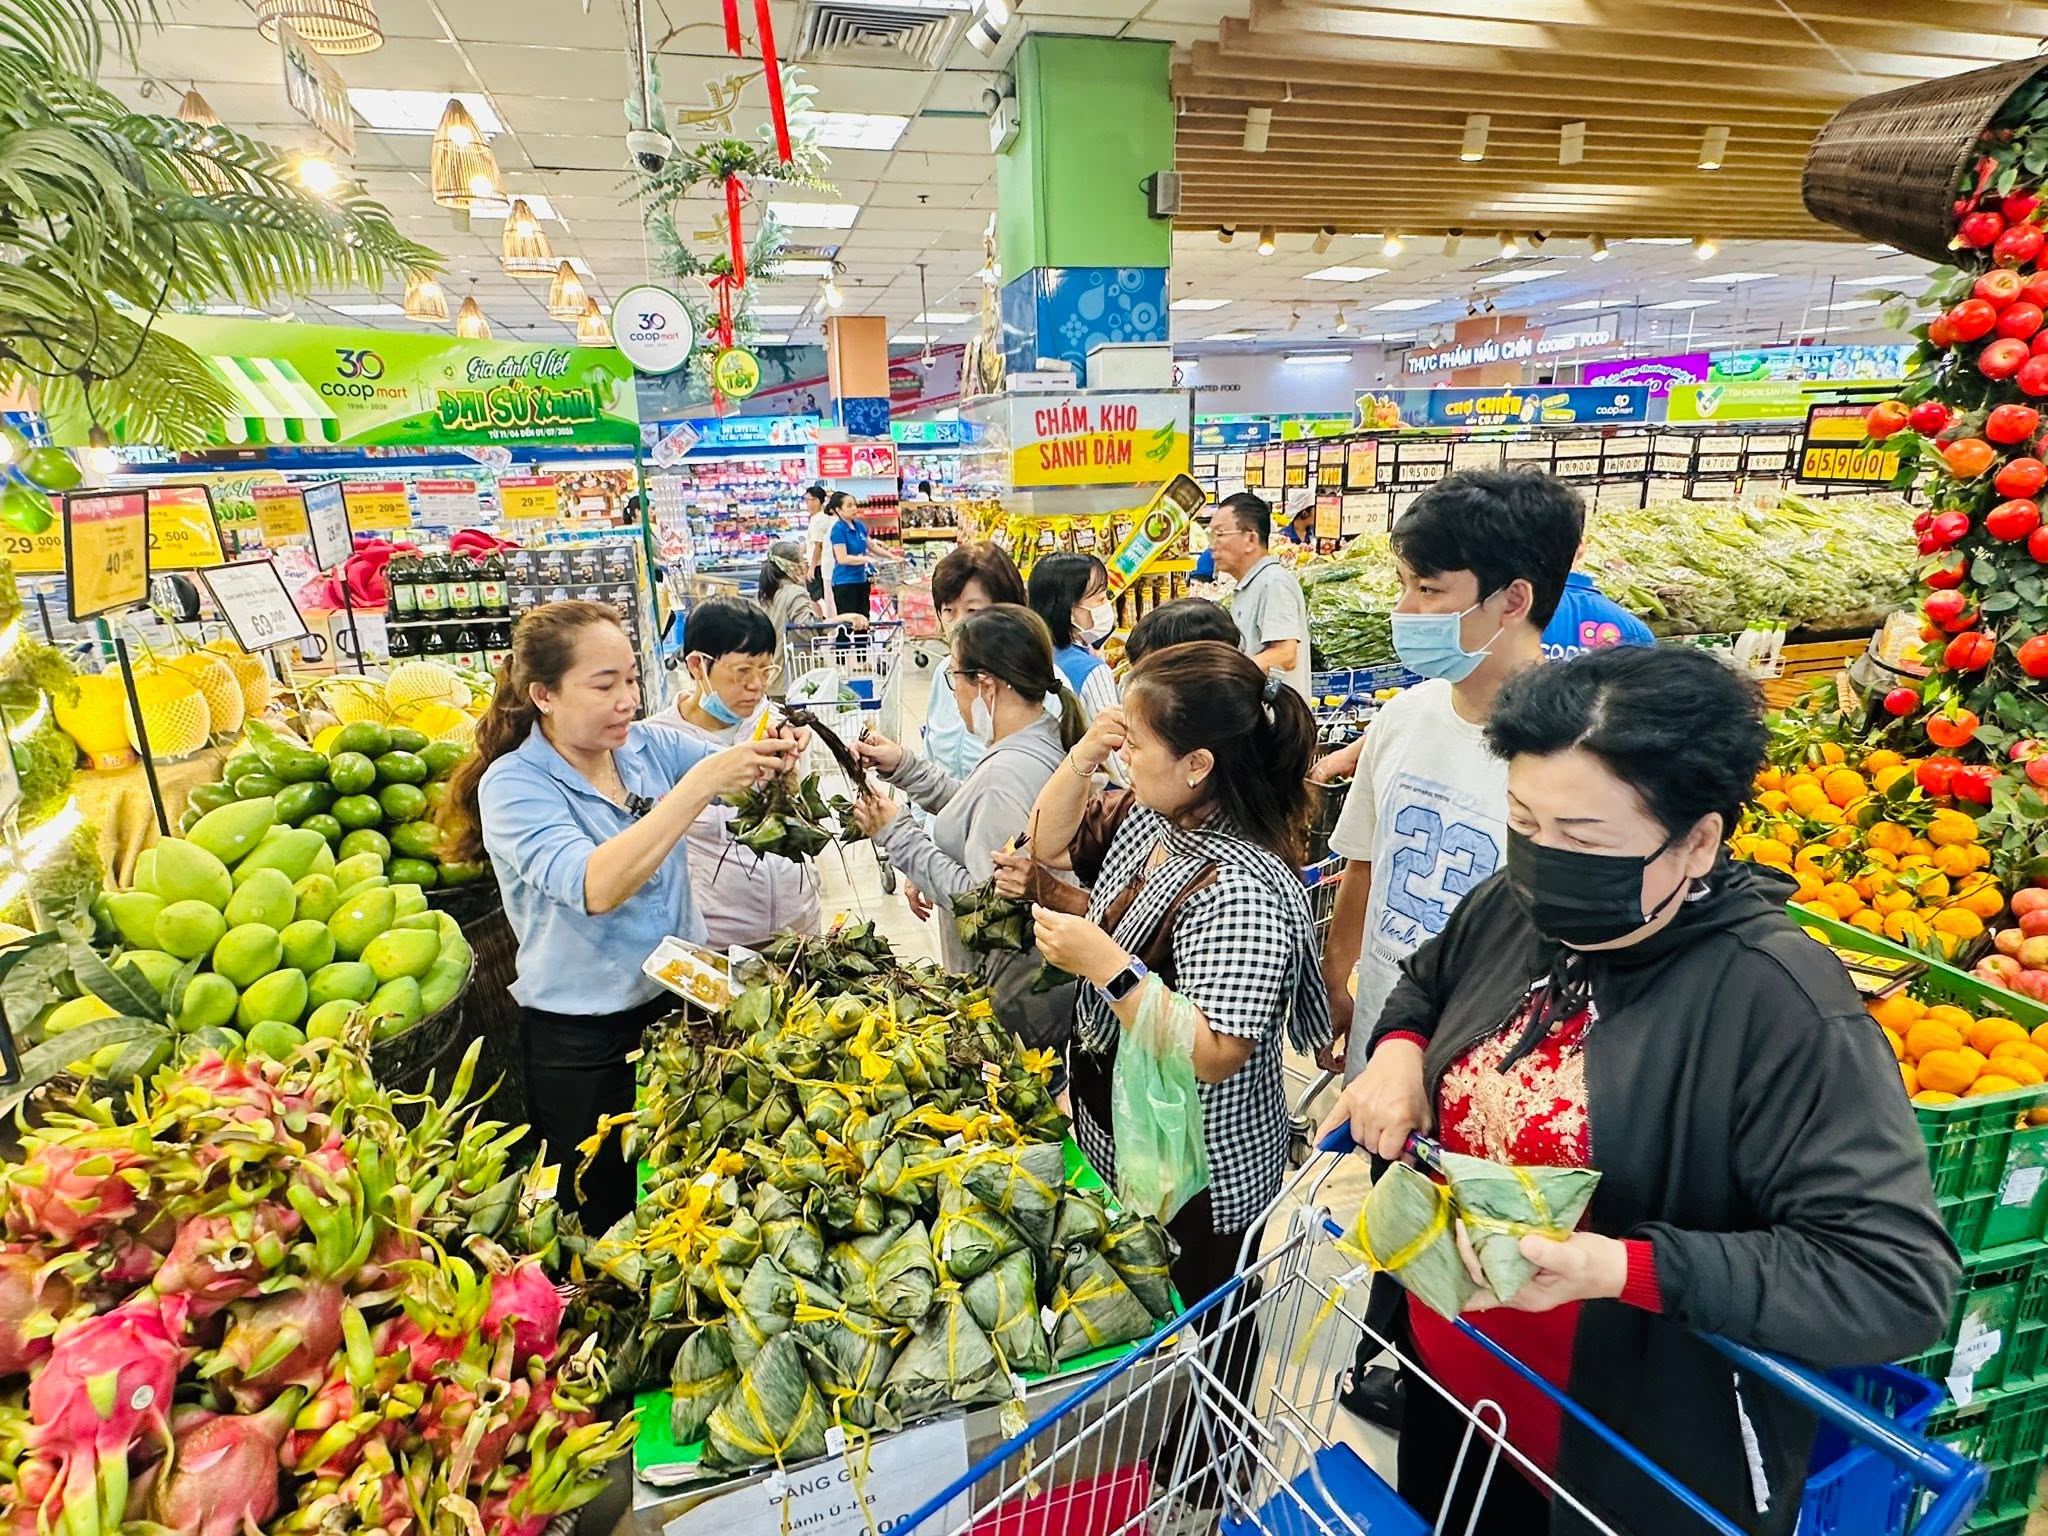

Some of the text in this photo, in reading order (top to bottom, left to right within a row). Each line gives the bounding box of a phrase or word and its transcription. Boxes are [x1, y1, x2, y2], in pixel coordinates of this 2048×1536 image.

[467, 350, 572, 385] Gia đình Việt
[1408, 356, 1438, 375] THỰC
[1439, 344, 1473, 370] PHẨM
[1474, 338, 1499, 364] NẤU
[1501, 336, 1533, 361] CHÍN
[436, 389, 486, 430] ĐẠI
[1034, 398, 1137, 437] CHẤM, KHO
[1814, 407, 1844, 418] Khuyến
[1040, 435, 1132, 470] SÁNH ĐẬM
[521, 497, 533, 507] 29
[4, 537, 33, 554] 29
[106, 552, 120, 576] 40
[284, 569, 307, 578] Select
[1387, 805, 1500, 935] 23
